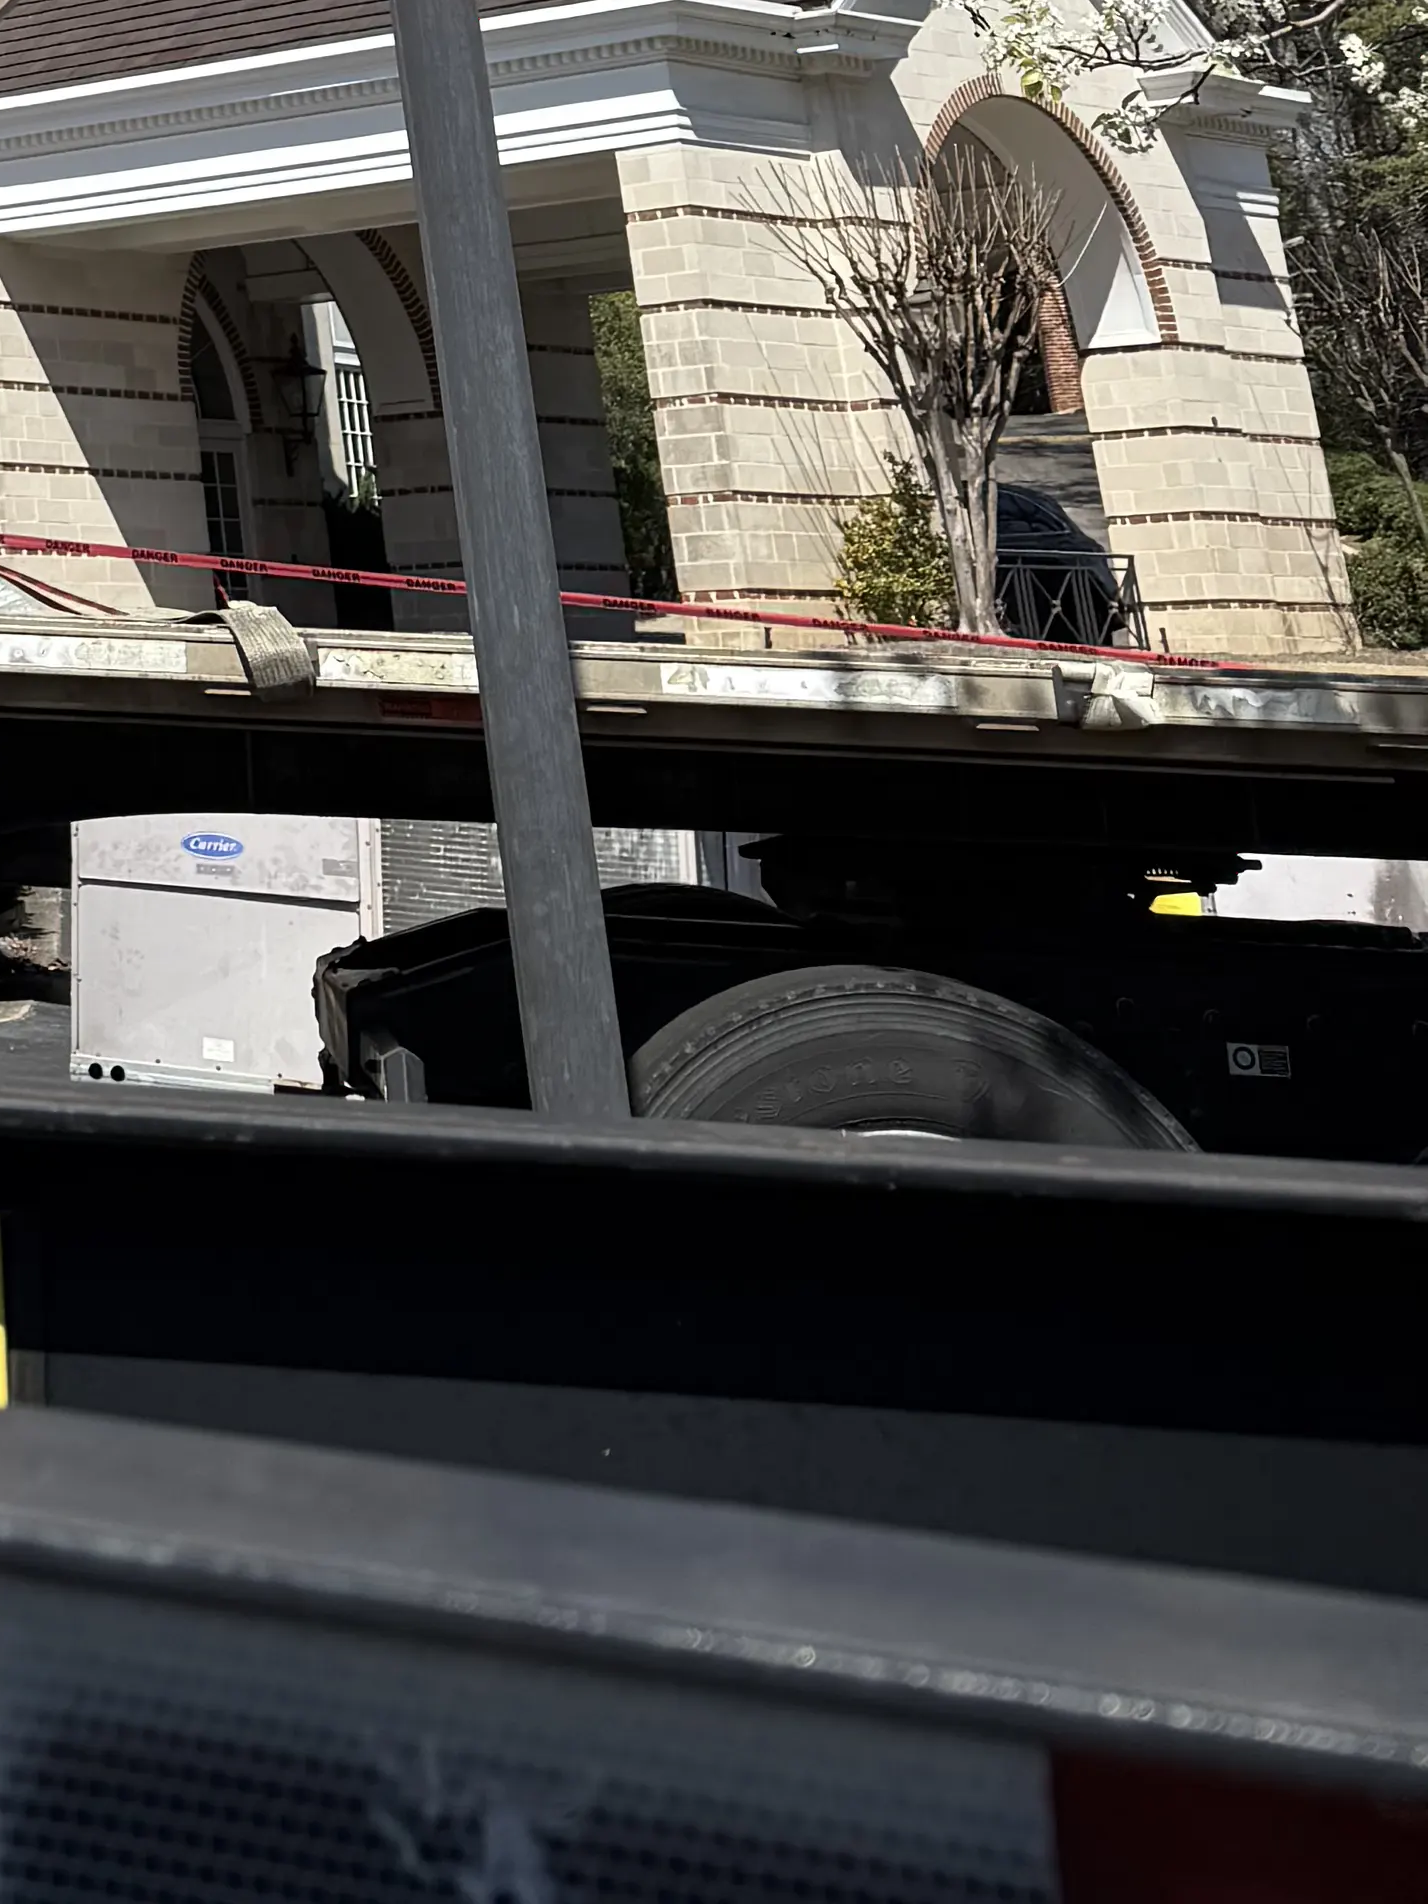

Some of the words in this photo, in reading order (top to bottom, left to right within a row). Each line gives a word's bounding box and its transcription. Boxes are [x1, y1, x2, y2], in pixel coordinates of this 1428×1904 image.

[45, 539, 91, 554] DANGER
[131, 549, 179, 563] DANGER
[220, 558, 268, 573] DANGER
[312, 568, 361, 583] DANGER
[406, 578, 456, 592] DANGER
[189, 837, 237, 853] Carrier
